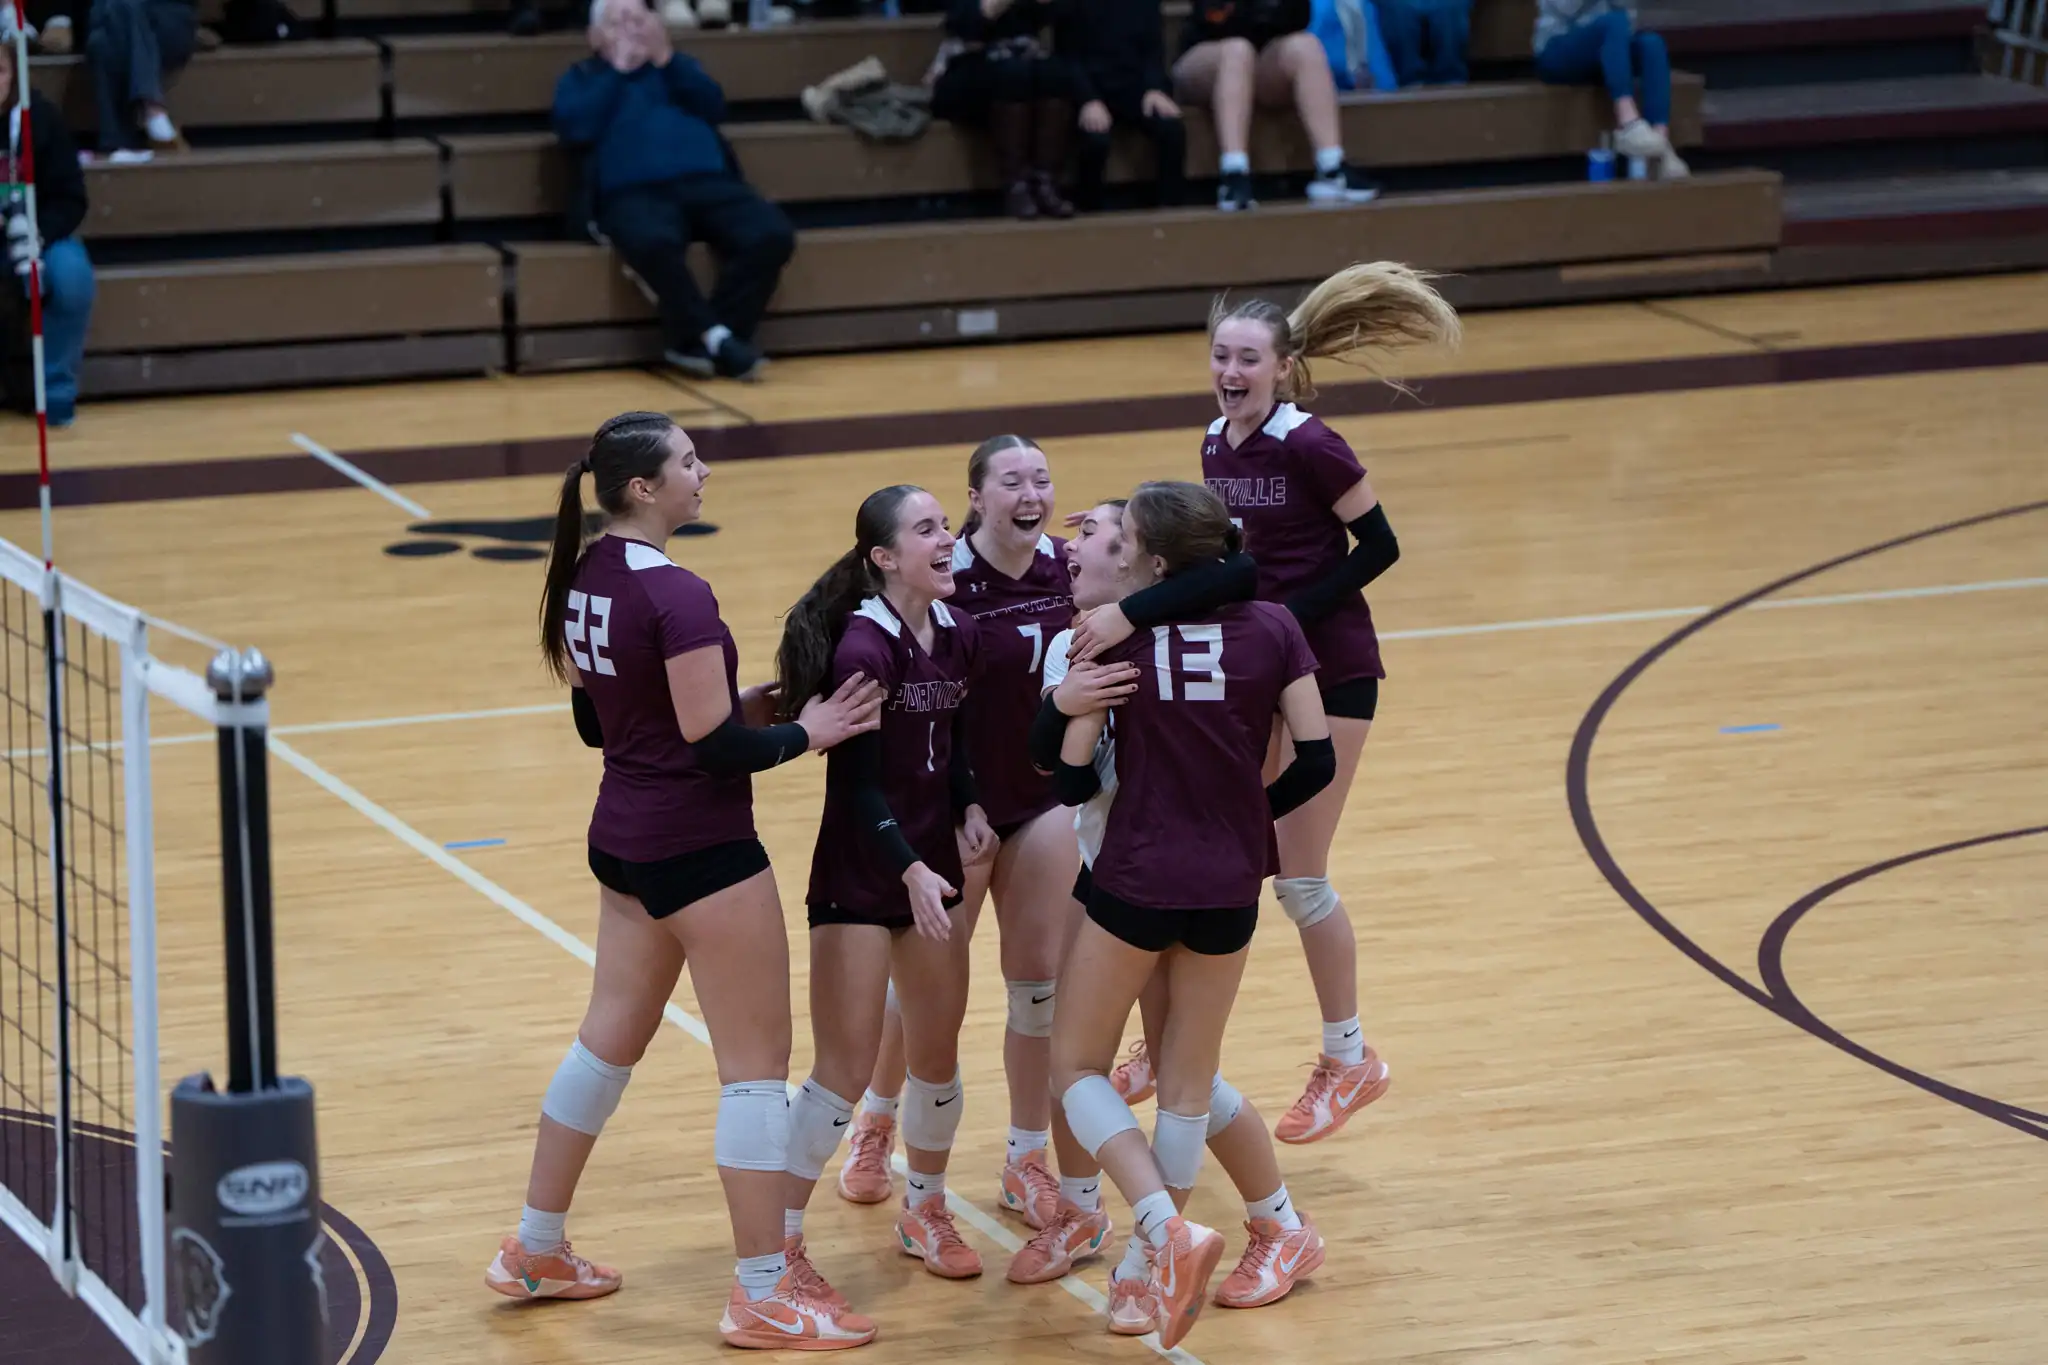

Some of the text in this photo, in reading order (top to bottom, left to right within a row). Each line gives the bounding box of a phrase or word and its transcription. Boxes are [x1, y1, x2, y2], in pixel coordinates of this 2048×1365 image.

[564, 588, 618, 677] 22
[1016, 622, 1043, 674] 7
[1151, 623, 1226, 701] 13
[926, 721, 936, 772] 1
